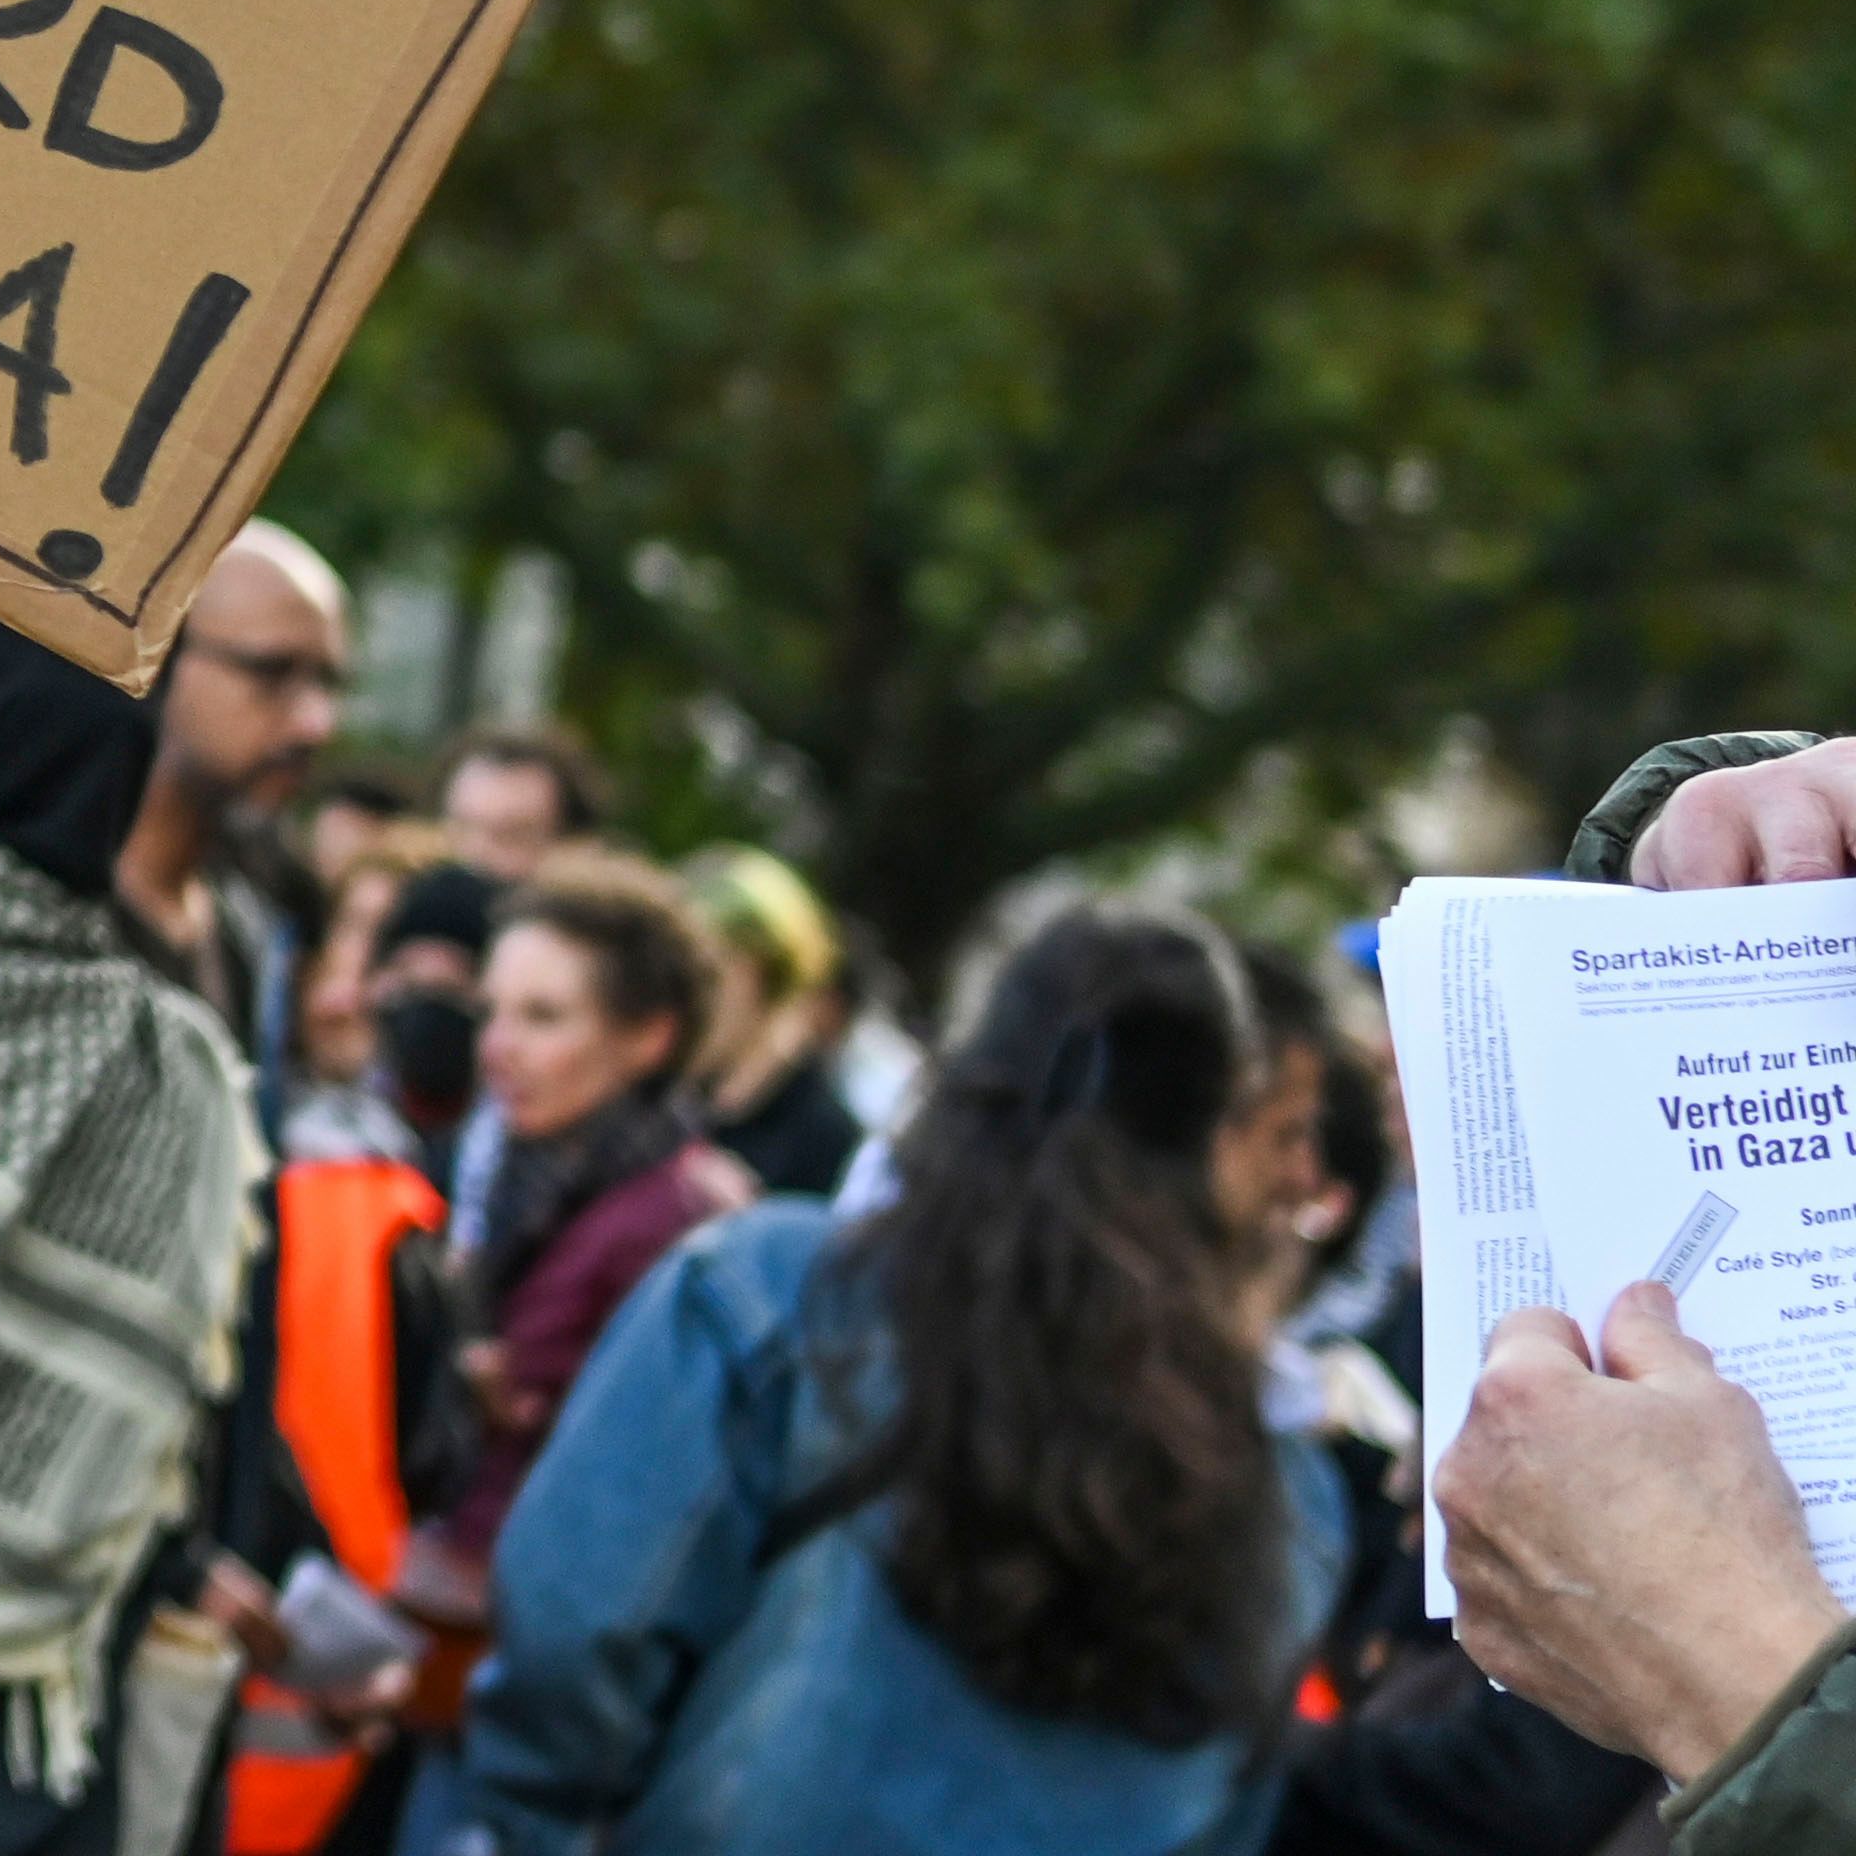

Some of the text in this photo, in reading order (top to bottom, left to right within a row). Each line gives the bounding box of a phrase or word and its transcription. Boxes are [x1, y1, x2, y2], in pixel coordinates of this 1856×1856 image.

[1571, 935, 1856, 976] Spartakist-Arbeiter
[1677, 1050, 1751, 1077] Aufruf
[1759, 1052, 1796, 1071] zur
[1658, 1084, 1849, 1131] Verteidigt
[1688, 1137, 1724, 1172] in
[1737, 1132, 1831, 1168] Gaza
[1715, 1252, 1765, 1273] Café
[1770, 1248, 1824, 1269] Style
[1833, 1297, 1856, 1315] S-
